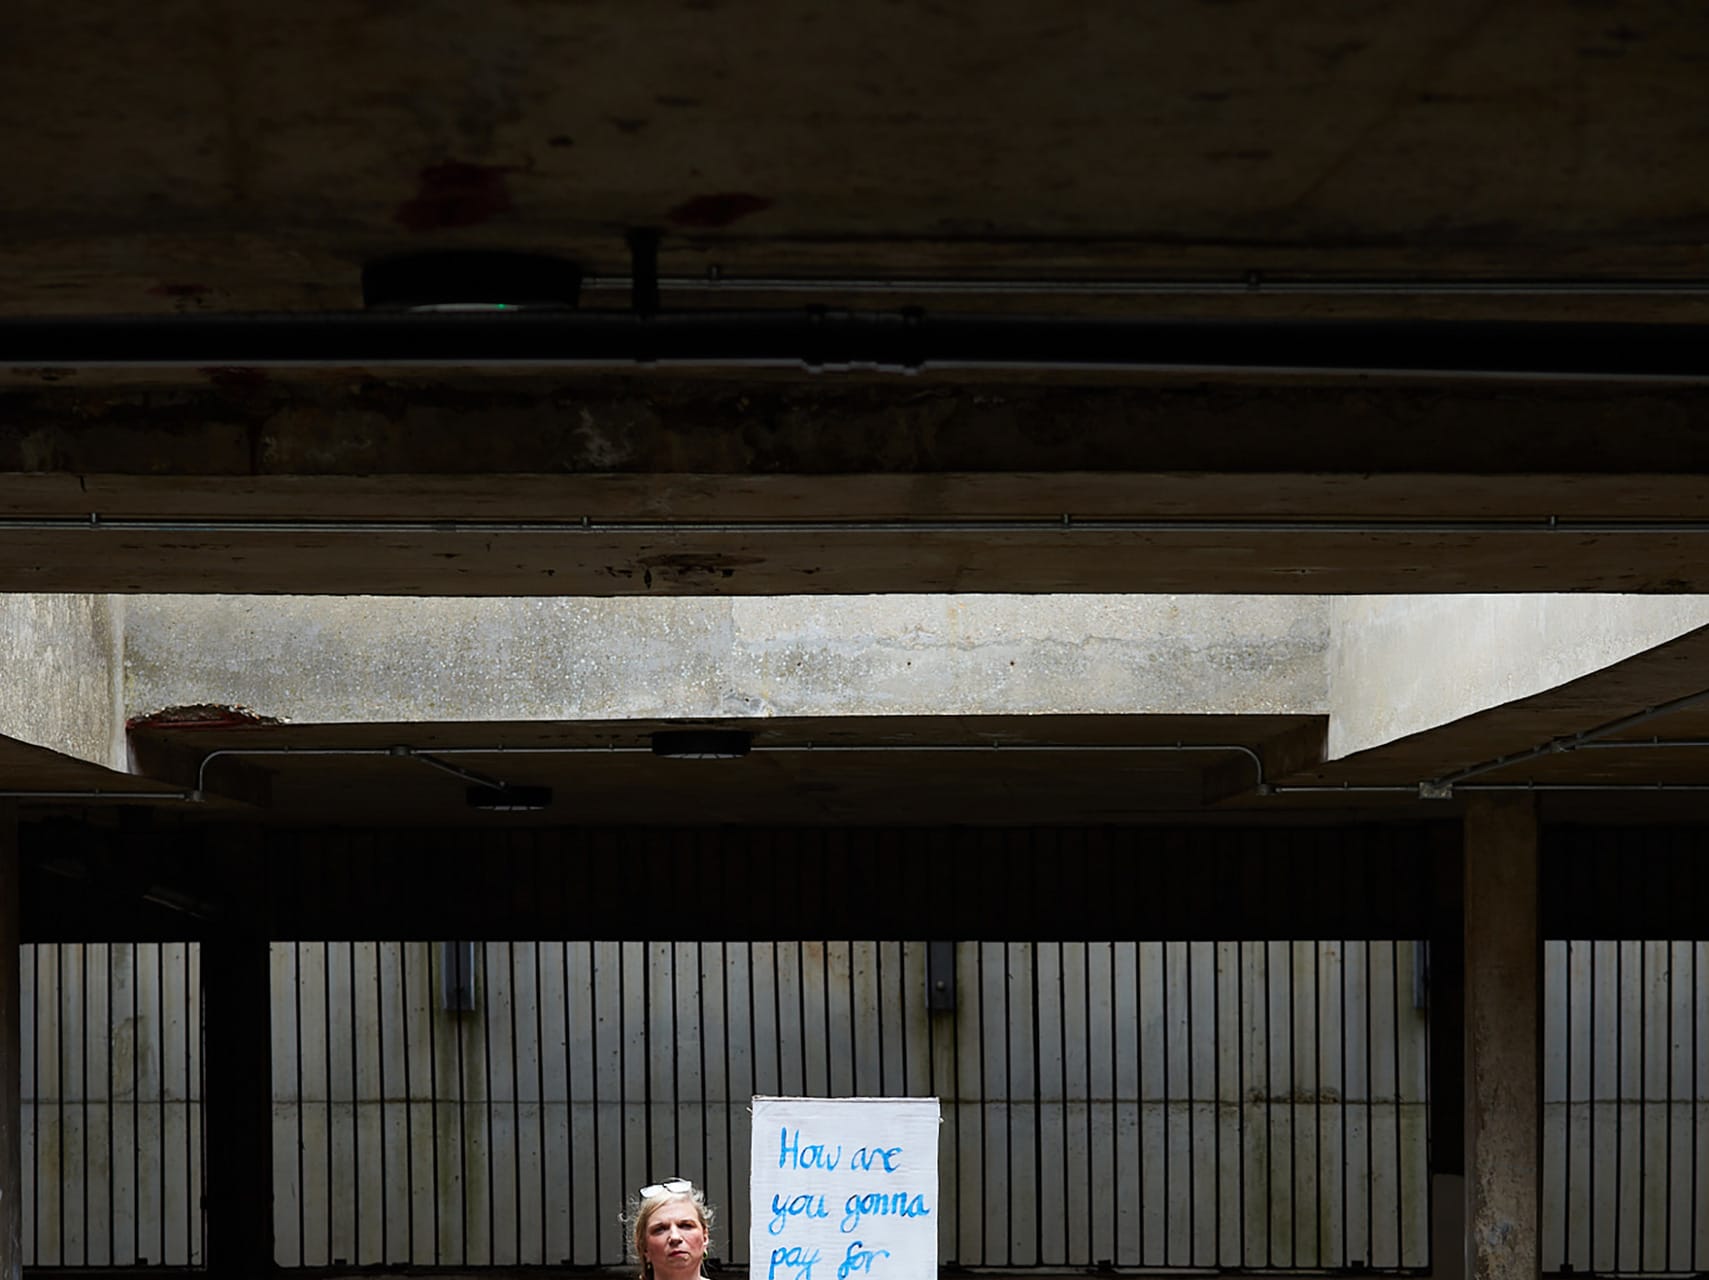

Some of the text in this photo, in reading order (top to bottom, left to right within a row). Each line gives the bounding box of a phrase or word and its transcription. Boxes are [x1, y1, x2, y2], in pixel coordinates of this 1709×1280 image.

[779, 1127, 903, 1173] How are
[768, 1190, 930, 1236] you gonna
[837, 1240, 890, 1280] for
